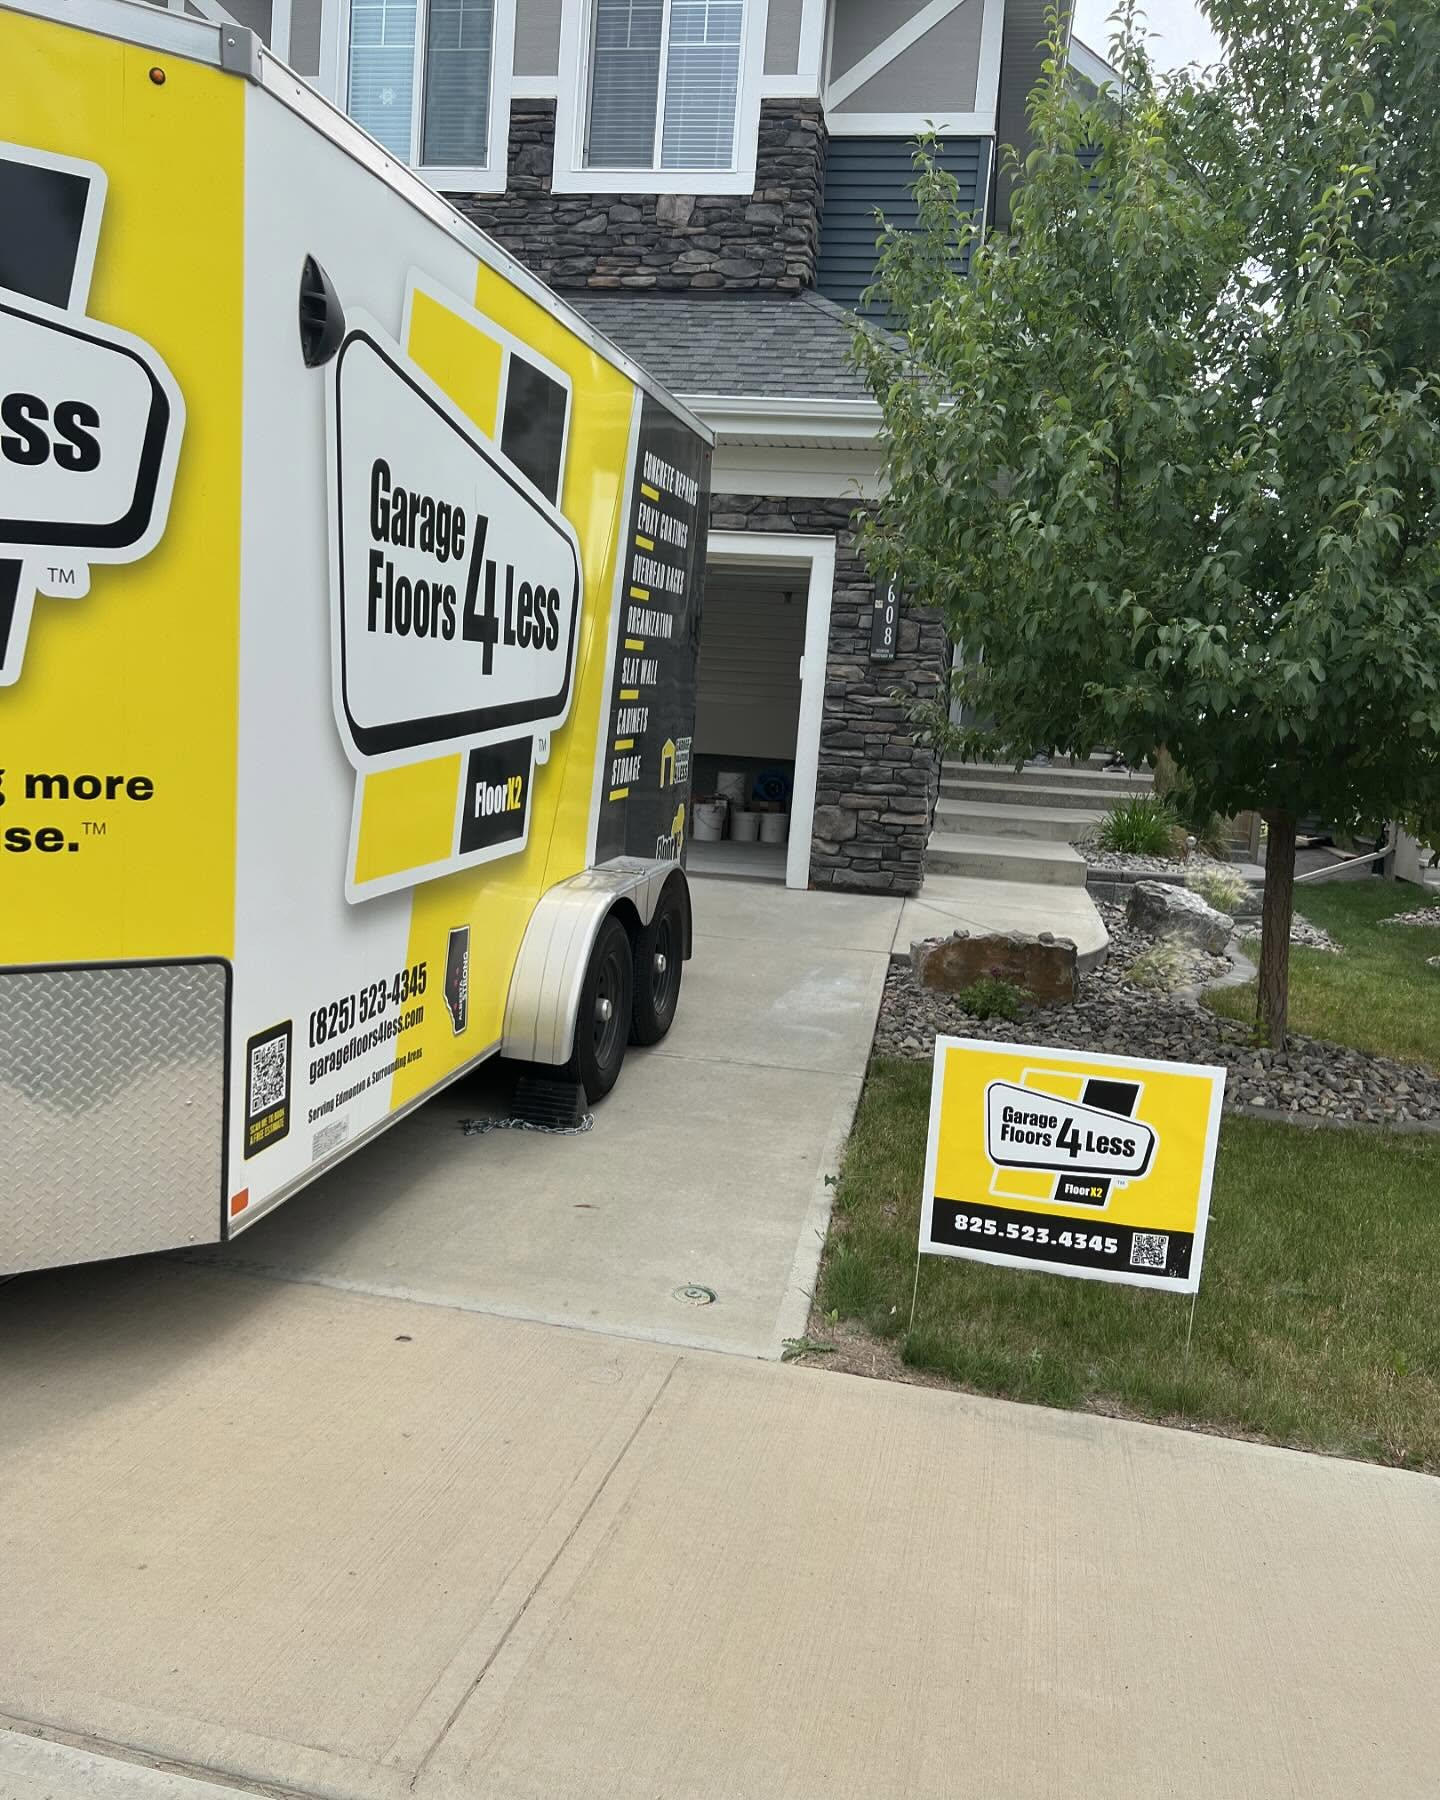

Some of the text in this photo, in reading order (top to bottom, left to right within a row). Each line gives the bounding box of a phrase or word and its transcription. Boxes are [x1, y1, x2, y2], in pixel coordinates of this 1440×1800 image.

[643, 450, 698, 507] CONCRETE REPAIRS
[369, 457, 466, 563] Garage
[637, 502, 688, 549] EPOXY COATINGS
[367, 513, 560, 676] Floors 4 Less
[632, 554, 685, 595] OVERHEAD RACKS
[626, 605, 673, 639] ORGANIZATION
[621, 657, 658, 685] SLAT WALL
[616, 707, 649, 735] CABINETS
[25, 774, 154, 801] more
[611, 755, 642, 786] STORAGE
[474, 775, 522, 818] FloorX2
[308, 961, 427, 1049] (825) 523-4345
[309, 1005, 424, 1085] garagefloors4less.com
[308, 1048, 422, 1124] Serving Edmonton & Surrounding Areas
[1000, 1117, 1136, 1158] Floors 4 Less
[1001, 1105, 1058, 1130] Garage
[1064, 1182, 1103, 1199] FloorX2
[954, 1213, 1119, 1255] 825.523.4345
